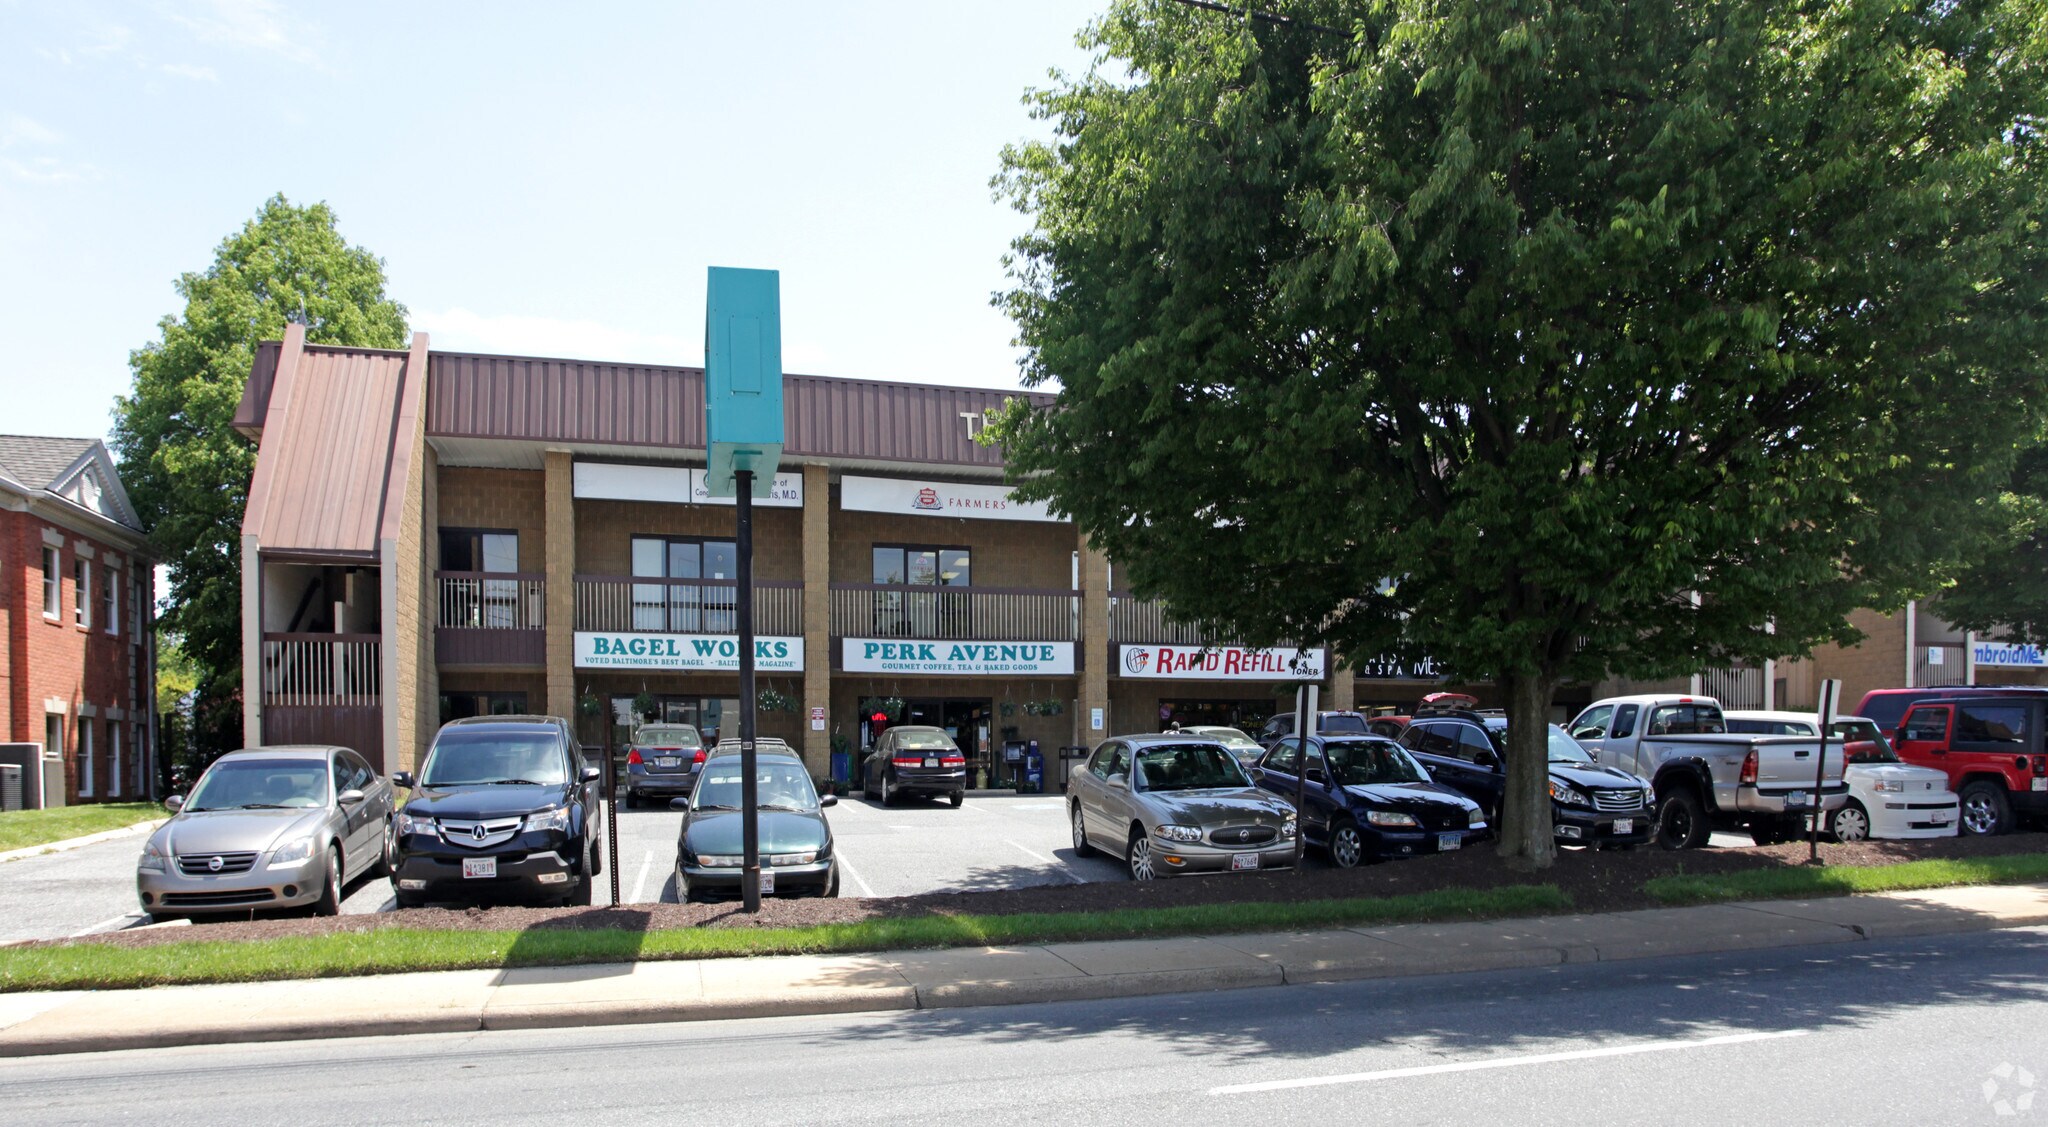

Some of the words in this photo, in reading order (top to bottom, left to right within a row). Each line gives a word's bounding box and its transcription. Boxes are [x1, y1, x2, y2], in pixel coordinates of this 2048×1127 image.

[782, 489, 799, 500] M.D.
[949, 498, 1006, 510] FARMERS
[593, 637, 681, 657] BAGEL
[691, 639, 788, 659] WOKS
[863, 642, 937, 661] PERK
[947, 644, 1055, 661] AVENUE
[584, 656, 610, 664] VOTED
[611, 657, 659, 665] BALTIMORE'S
[1224, 649, 1286, 675] REFILL
[881, 662, 921, 670] GOURMET
[923, 663, 955, 671] COFFEE,
[1377, 665, 1403, 675] SPA
